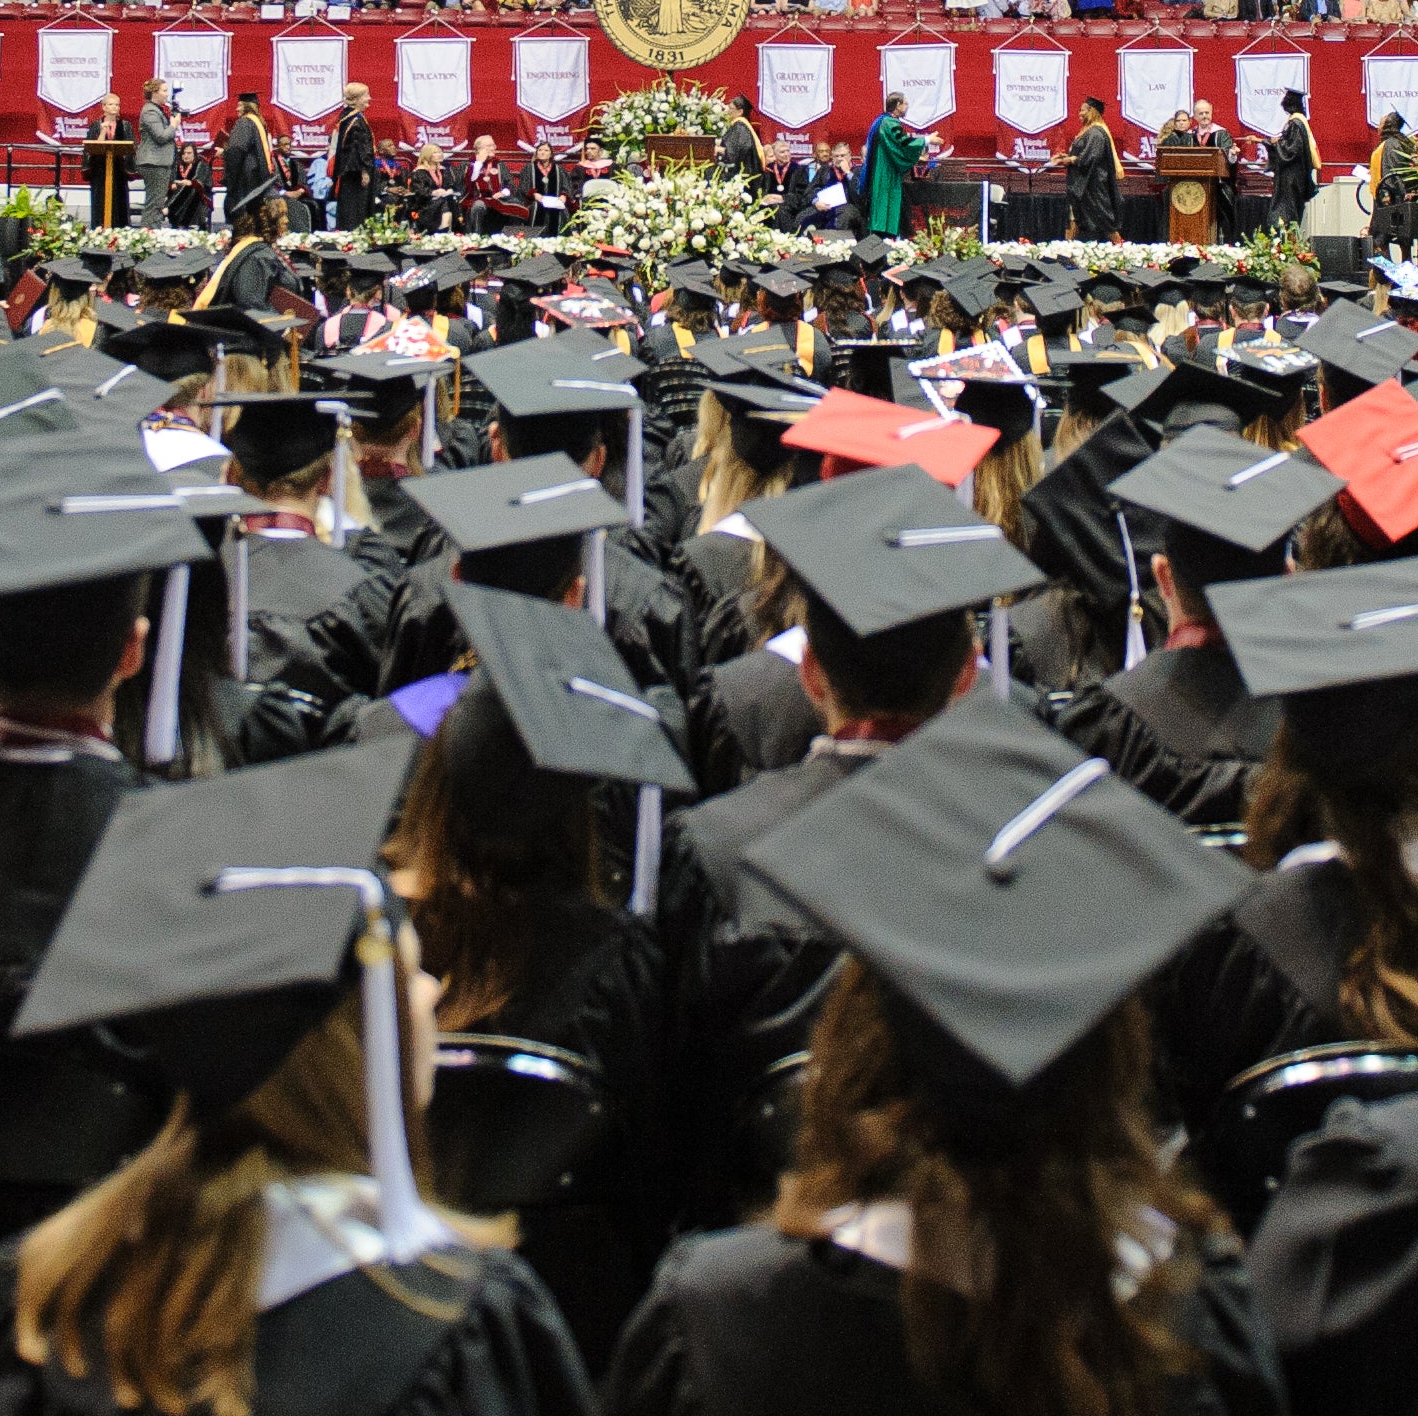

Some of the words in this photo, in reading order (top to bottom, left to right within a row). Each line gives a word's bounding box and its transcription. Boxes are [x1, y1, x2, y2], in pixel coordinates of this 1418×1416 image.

[648, 48, 685, 63] 1831
[287, 64, 334, 74] CONTINUING
[412, 72, 457, 81] EDUCATION
[526, 71, 580, 81] ENGINEERING
[776, 72, 816, 81] GRADUATE
[296, 77, 325, 85] STUDIES
[902, 79, 936, 87] HONORS
[781, 85, 810, 94] SCHOOL
[1006, 85, 1057, 93] ENVIRONMENTAL
[1148, 83, 1167, 91] LAW
[1254, 88, 1287, 96] NURSIN
[1018, 95, 1046, 103] SCIENCES
